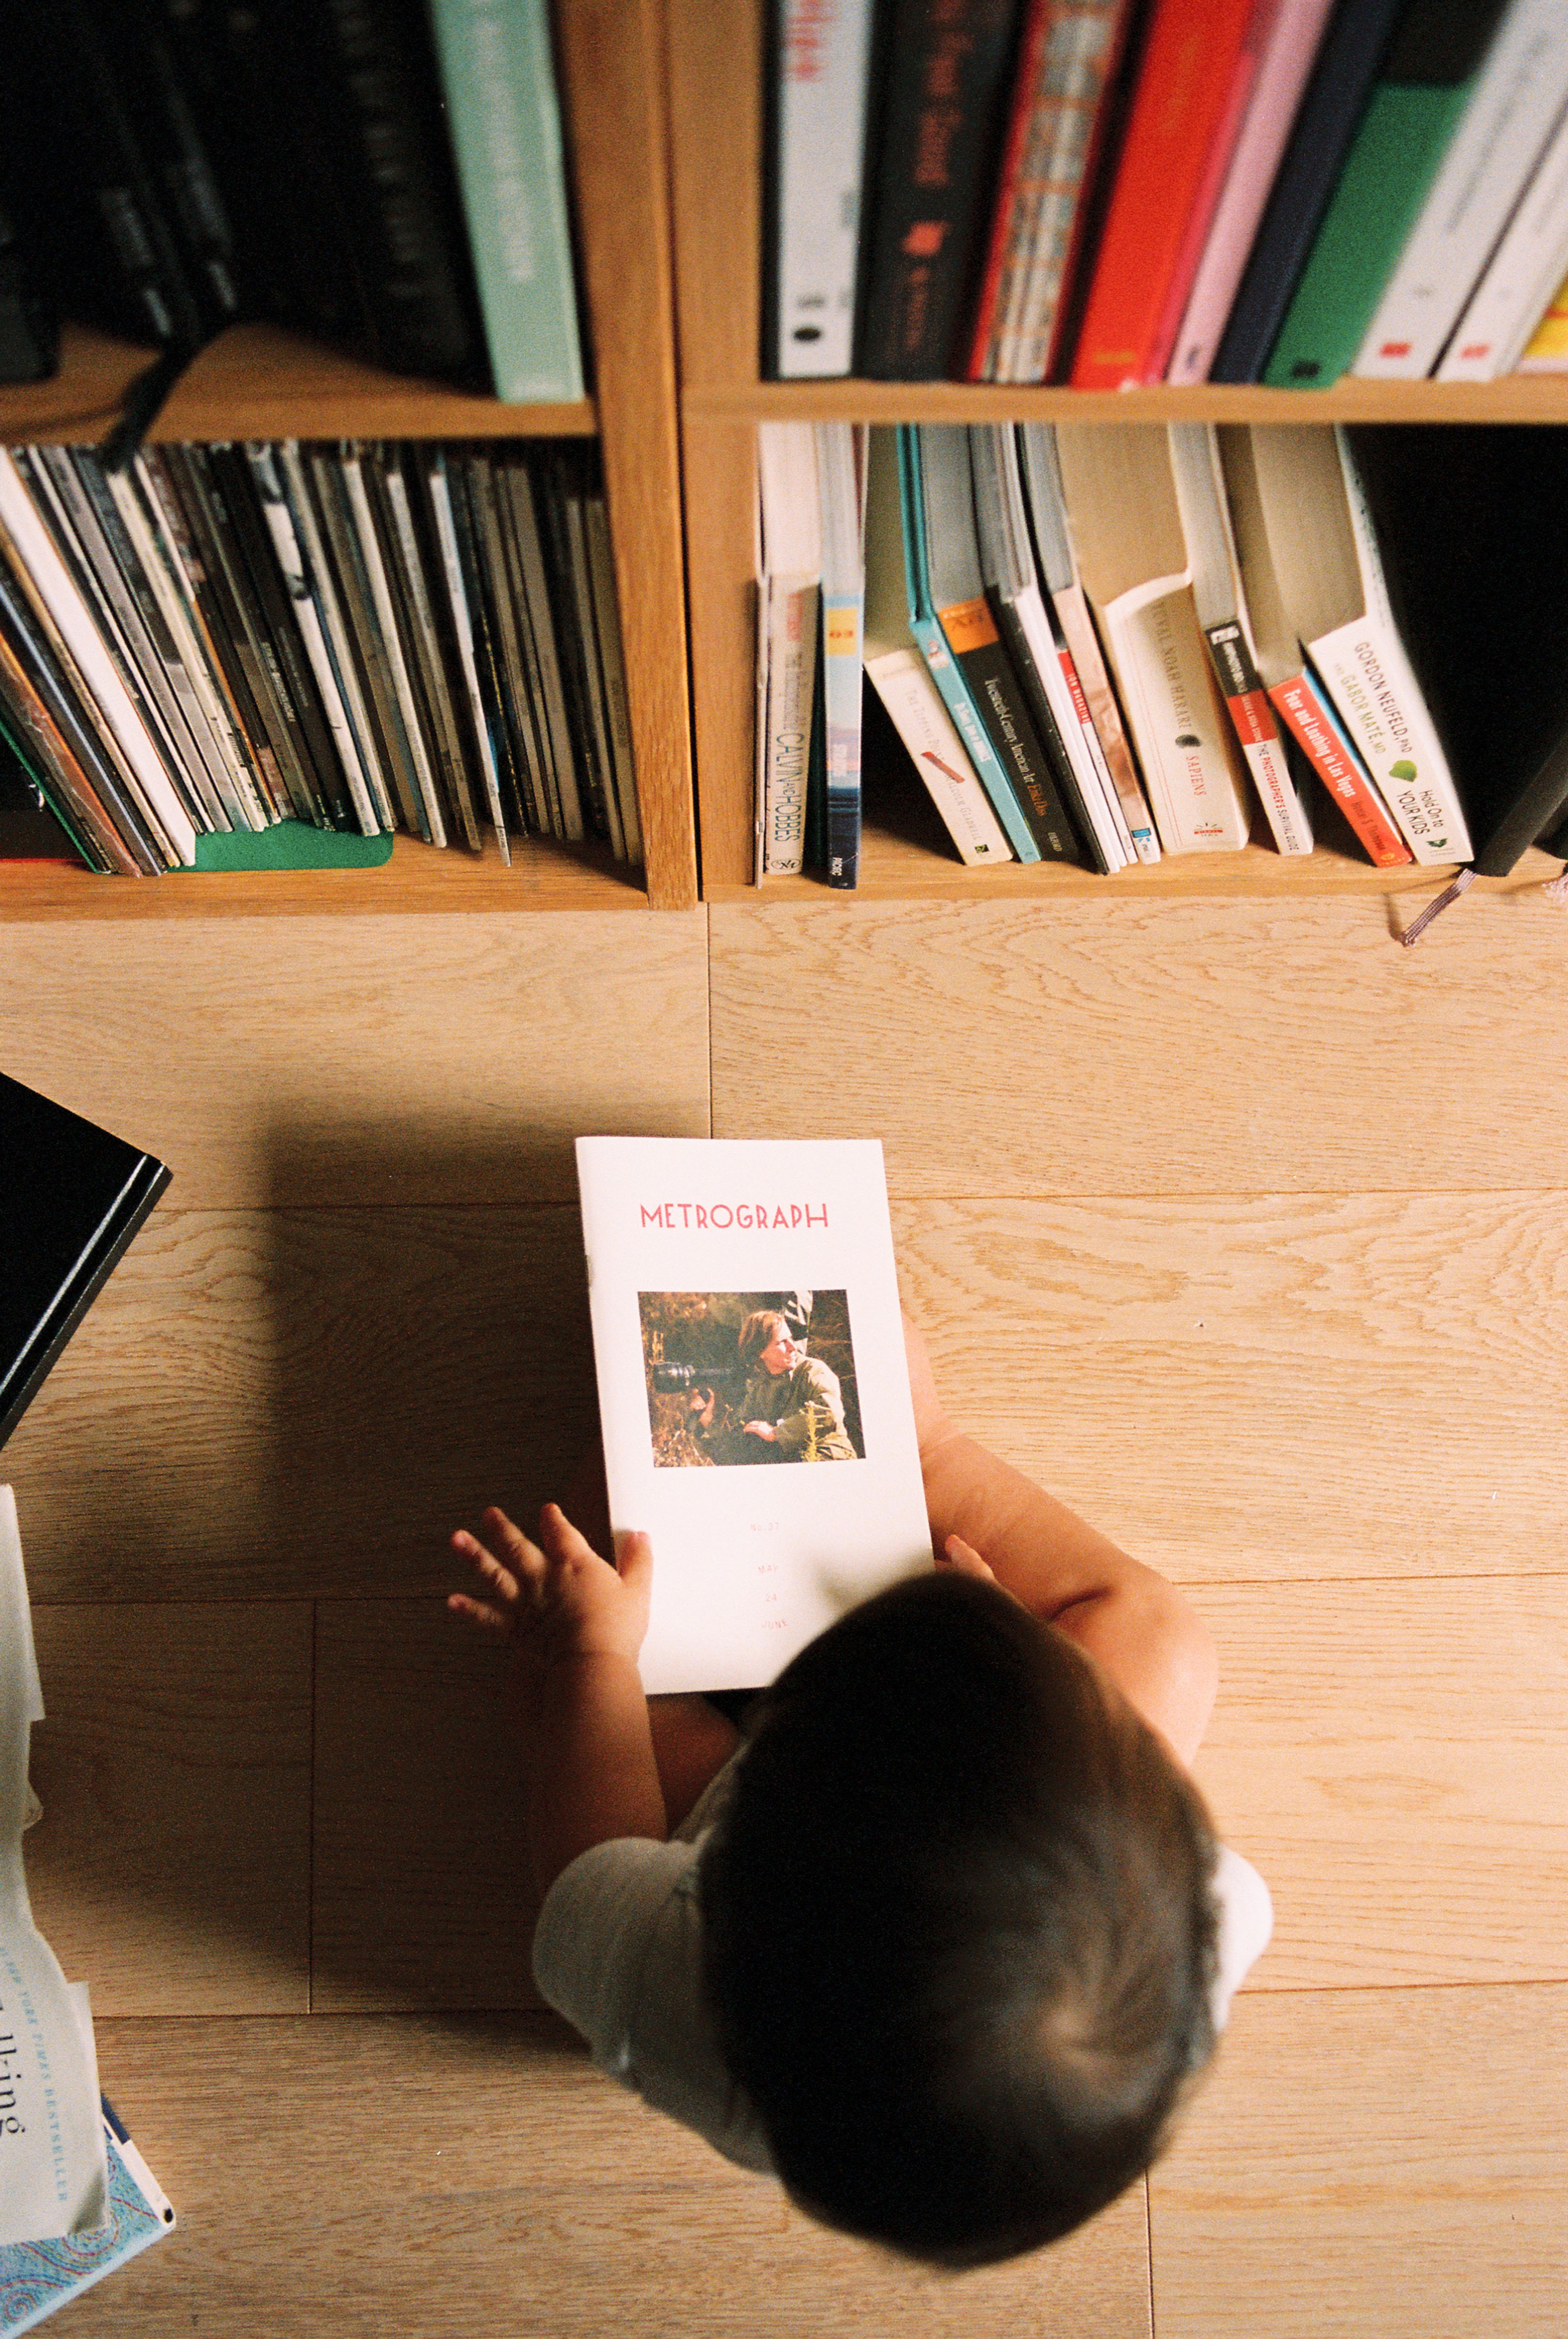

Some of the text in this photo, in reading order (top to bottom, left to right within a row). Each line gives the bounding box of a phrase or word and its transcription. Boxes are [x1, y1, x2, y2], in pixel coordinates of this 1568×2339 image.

[1163, 649, 1180, 682] NOAH
[1354, 642, 1386, 690] GORDON
[1073, 689, 1091, 723] MAGAZINE
[1171, 686, 1191, 729] HARARI
[1341, 675, 1368, 709] GABOR
[776, 733, 804, 782] CALVIN
[1011, 740, 1030, 772] American
[1023, 771, 1036, 785] Art
[1284, 689, 1356, 799] Fear and Loathing in Las Vegas
[783, 783, 795, 794] AND
[1187, 755, 1206, 797] SAPIENS
[775, 794, 801, 842] HOBBES
[1257, 745, 1298, 851] THE PHOTOGRAPHER'S SURVIVAL GUIDE
[1397, 790, 1430, 836] YOUR KIDS
[1421, 789, 1443, 829] Hold On to
[640, 1203, 829, 1229] METROGRAPH
[758, 1565, 779, 1574] MAY
[761, 1619, 788, 1630] JUNE
[19, 1991, 37, 2025] YORK
[32, 2033, 51, 2080] TIMES
[45, 2088, 67, 2201] BESTSELLER
